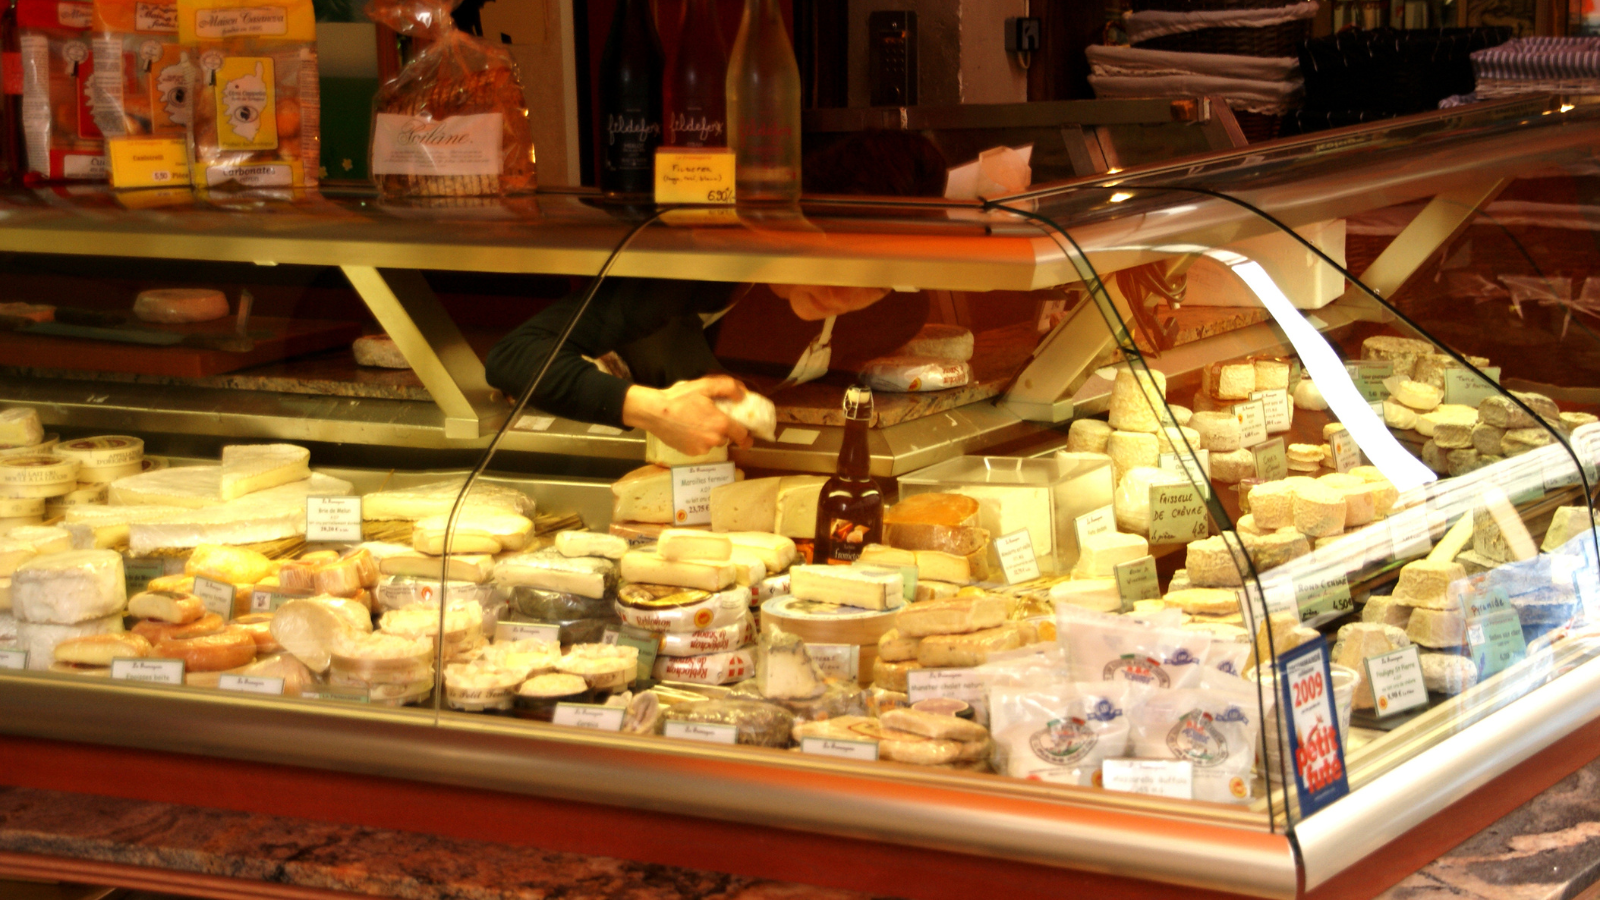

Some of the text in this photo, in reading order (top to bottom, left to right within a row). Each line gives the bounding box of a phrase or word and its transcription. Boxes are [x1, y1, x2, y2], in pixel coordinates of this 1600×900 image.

[198, 15, 238, 28] Maison
[1153, 510, 1164, 522] DE
[666, 666, 708, 679] Reblochon
[1292, 671, 1324, 708] 2009
